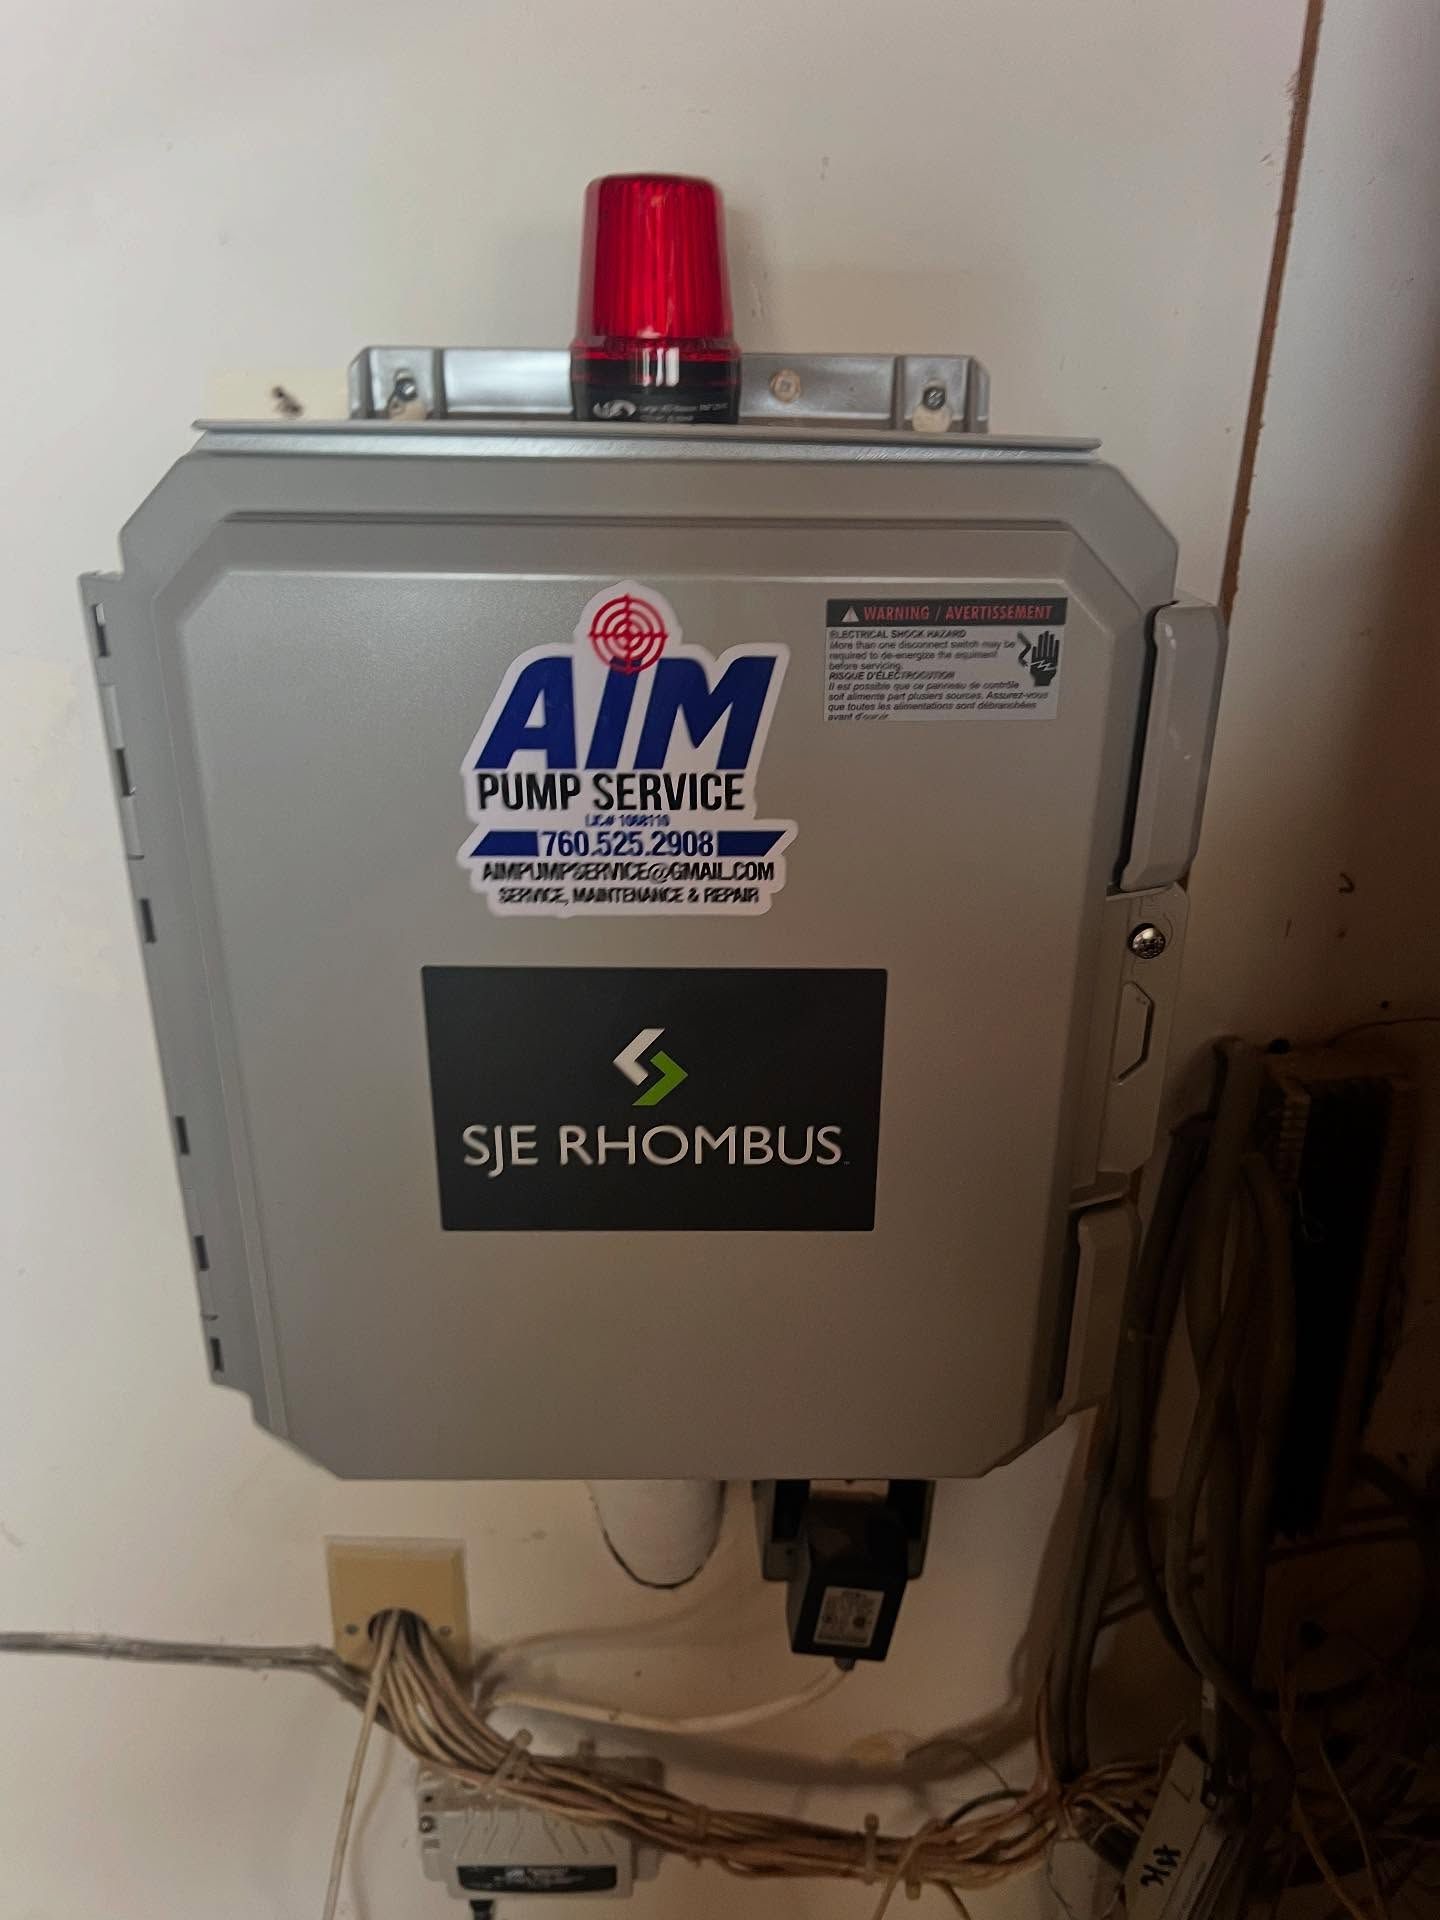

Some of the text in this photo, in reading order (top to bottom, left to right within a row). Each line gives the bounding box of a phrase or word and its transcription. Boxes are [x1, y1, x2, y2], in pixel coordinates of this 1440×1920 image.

[863, 605, 930, 620] WARNING
[945, 604, 1053, 620] AVERTISSEMENT
[830, 629, 967, 639] ELECTRICAL SHOCK HAZARD
[829, 641, 853, 650] More
[855, 641, 877, 650] than
[898, 641, 948, 649] disconnect
[951, 641, 977, 649] switch
[982, 641, 1001, 650] may
[1003, 641, 1016, 649] be
[829, 651, 867, 663] required
[869, 652, 879, 660] to
[880, 651, 935, 662] de-energize
[937, 651, 952, 659] the
[829, 662, 904, 672] before servicing.
[829, 669, 956, 681] RISQUE D'ÉLECTROCUTION
[837, 682, 851, 691] est
[853, 682, 890, 692] possible
[893, 683, 911, 692] que
[926, 682, 967, 691] panneau
[969, 681, 981, 689] de
[828, 692, 845, 701] soit
[986, 691, 1048, 700] Assurez-vous
[828, 703, 845, 712] que
[847, 702, 875, 711] toutes
[877, 702, 893, 711] les
[894, 701, 953, 711] alimentations
[955, 701, 976, 710] sont
[474, 656, 778, 770] AIM
[828, 713, 853, 721] avant
[478, 773, 746, 811] PUMP SERVICE
[542, 831, 714, 857] 760.525.2908
[482, 862, 775, 884] AIMPUMPSERVICE@GMAIL.COM
[498, 887, 760, 906] SERVICE, MAINTENANCE & REPAIR
[461, 1124, 843, 1179] SJE RHOMBUS
